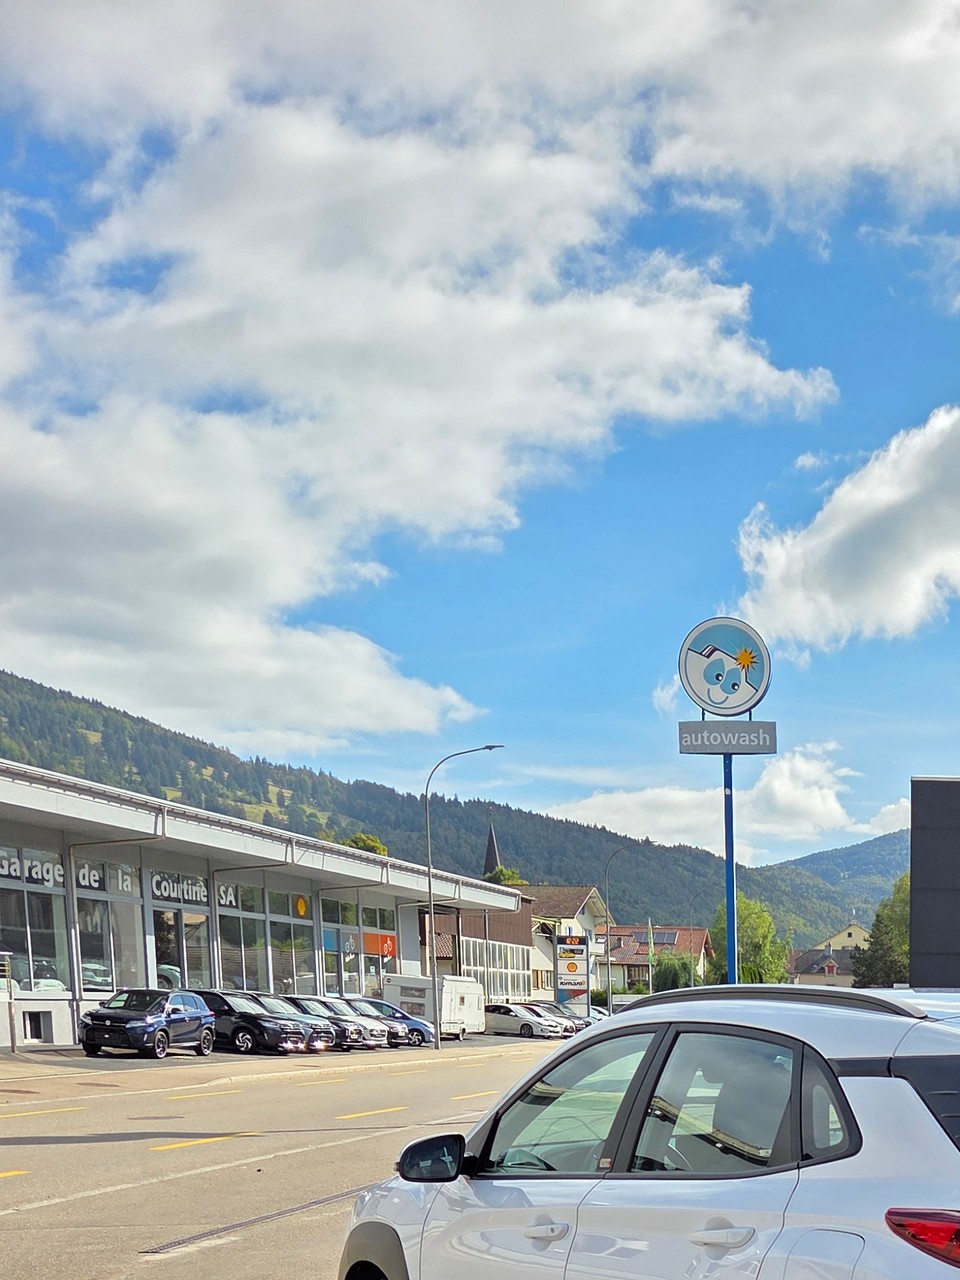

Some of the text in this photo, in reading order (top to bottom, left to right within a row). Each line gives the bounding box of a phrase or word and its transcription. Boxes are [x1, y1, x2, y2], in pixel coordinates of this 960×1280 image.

[681, 728, 770, 746] autowash
[78, 864, 100, 888] de
[117, 869, 132, 892] la
[151, 874, 208, 902] Courtine
[219, 885, 237, 906] SA
